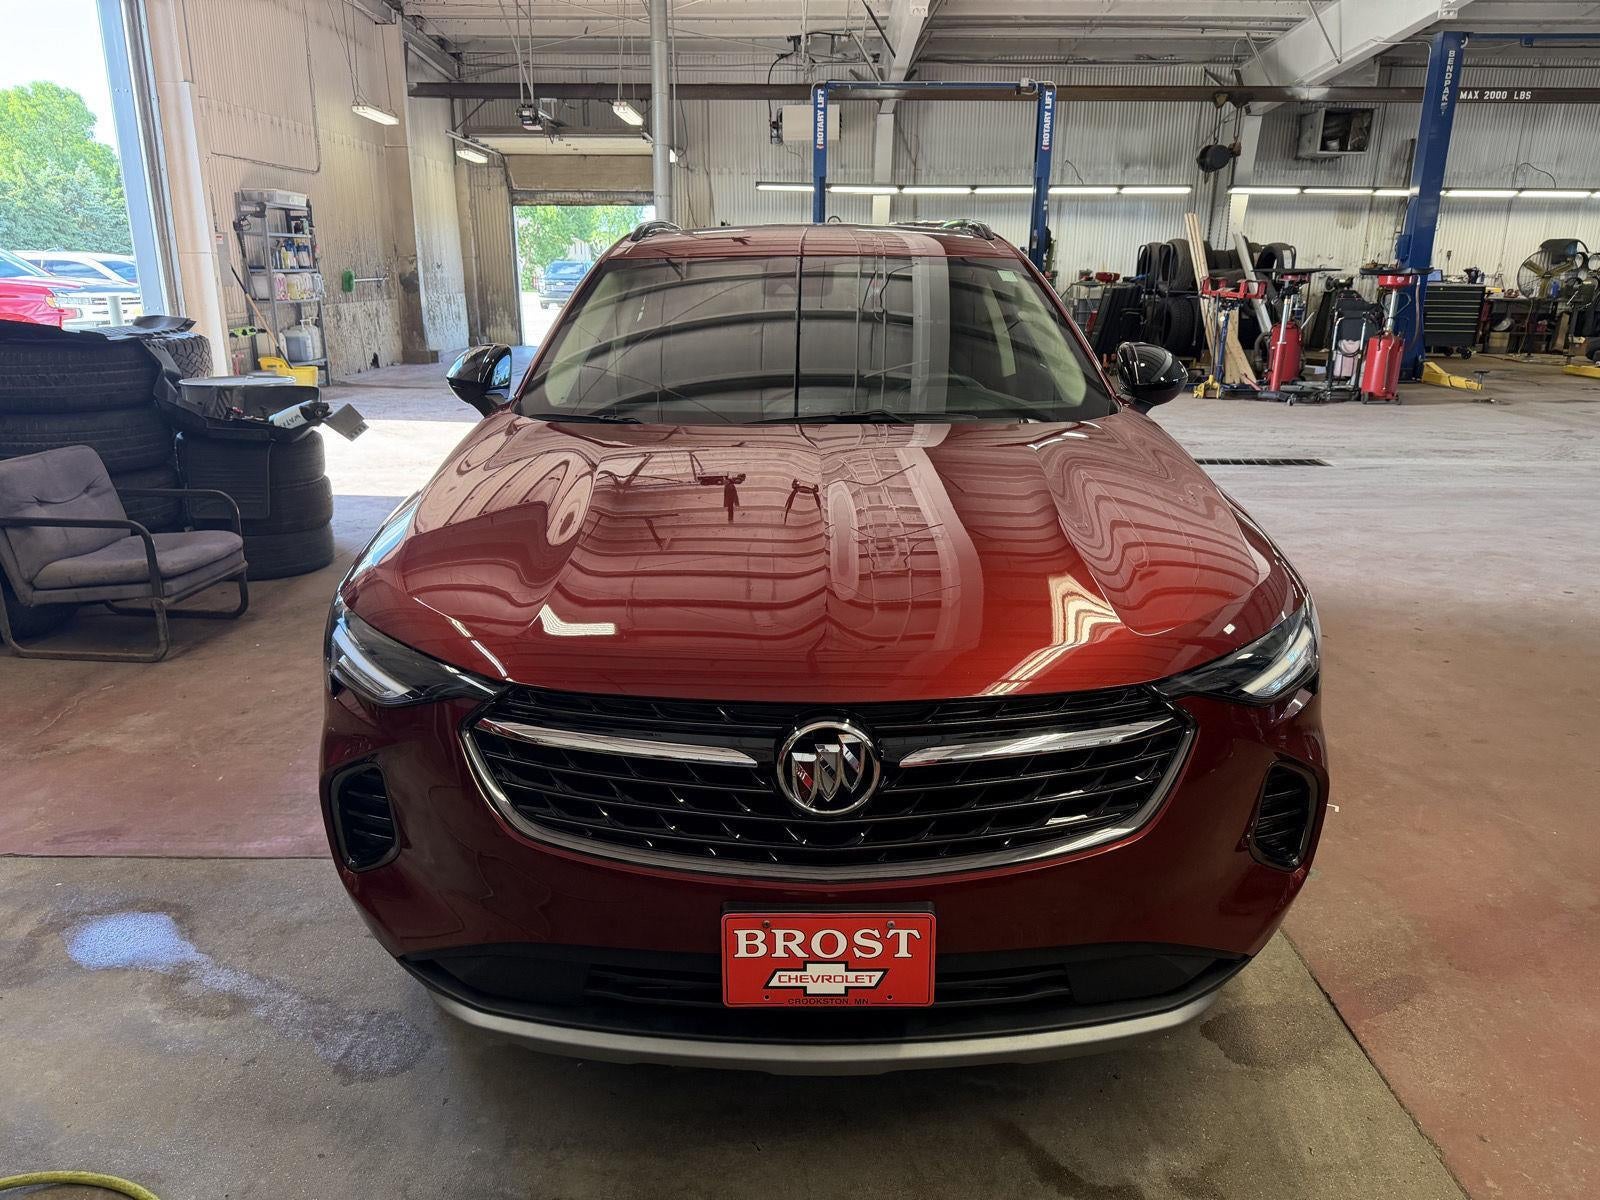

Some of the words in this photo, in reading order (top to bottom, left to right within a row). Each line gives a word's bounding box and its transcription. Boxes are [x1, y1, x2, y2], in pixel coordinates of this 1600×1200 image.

[1441, 50, 1456, 102] BENDPAK
[817, 89, 825, 108] LIFT
[1045, 91, 1053, 110] LIFT
[1460, 90, 1480, 100] MAX
[1483, 90, 1508, 100] 2000
[1514, 90, 1532, 100] LBS
[816, 110, 824, 145] ROTARY
[1043, 111, 1051, 146] ROTARY
[733, 928, 921, 959] BROST
[778, 974, 876, 984] CHEVROLET
